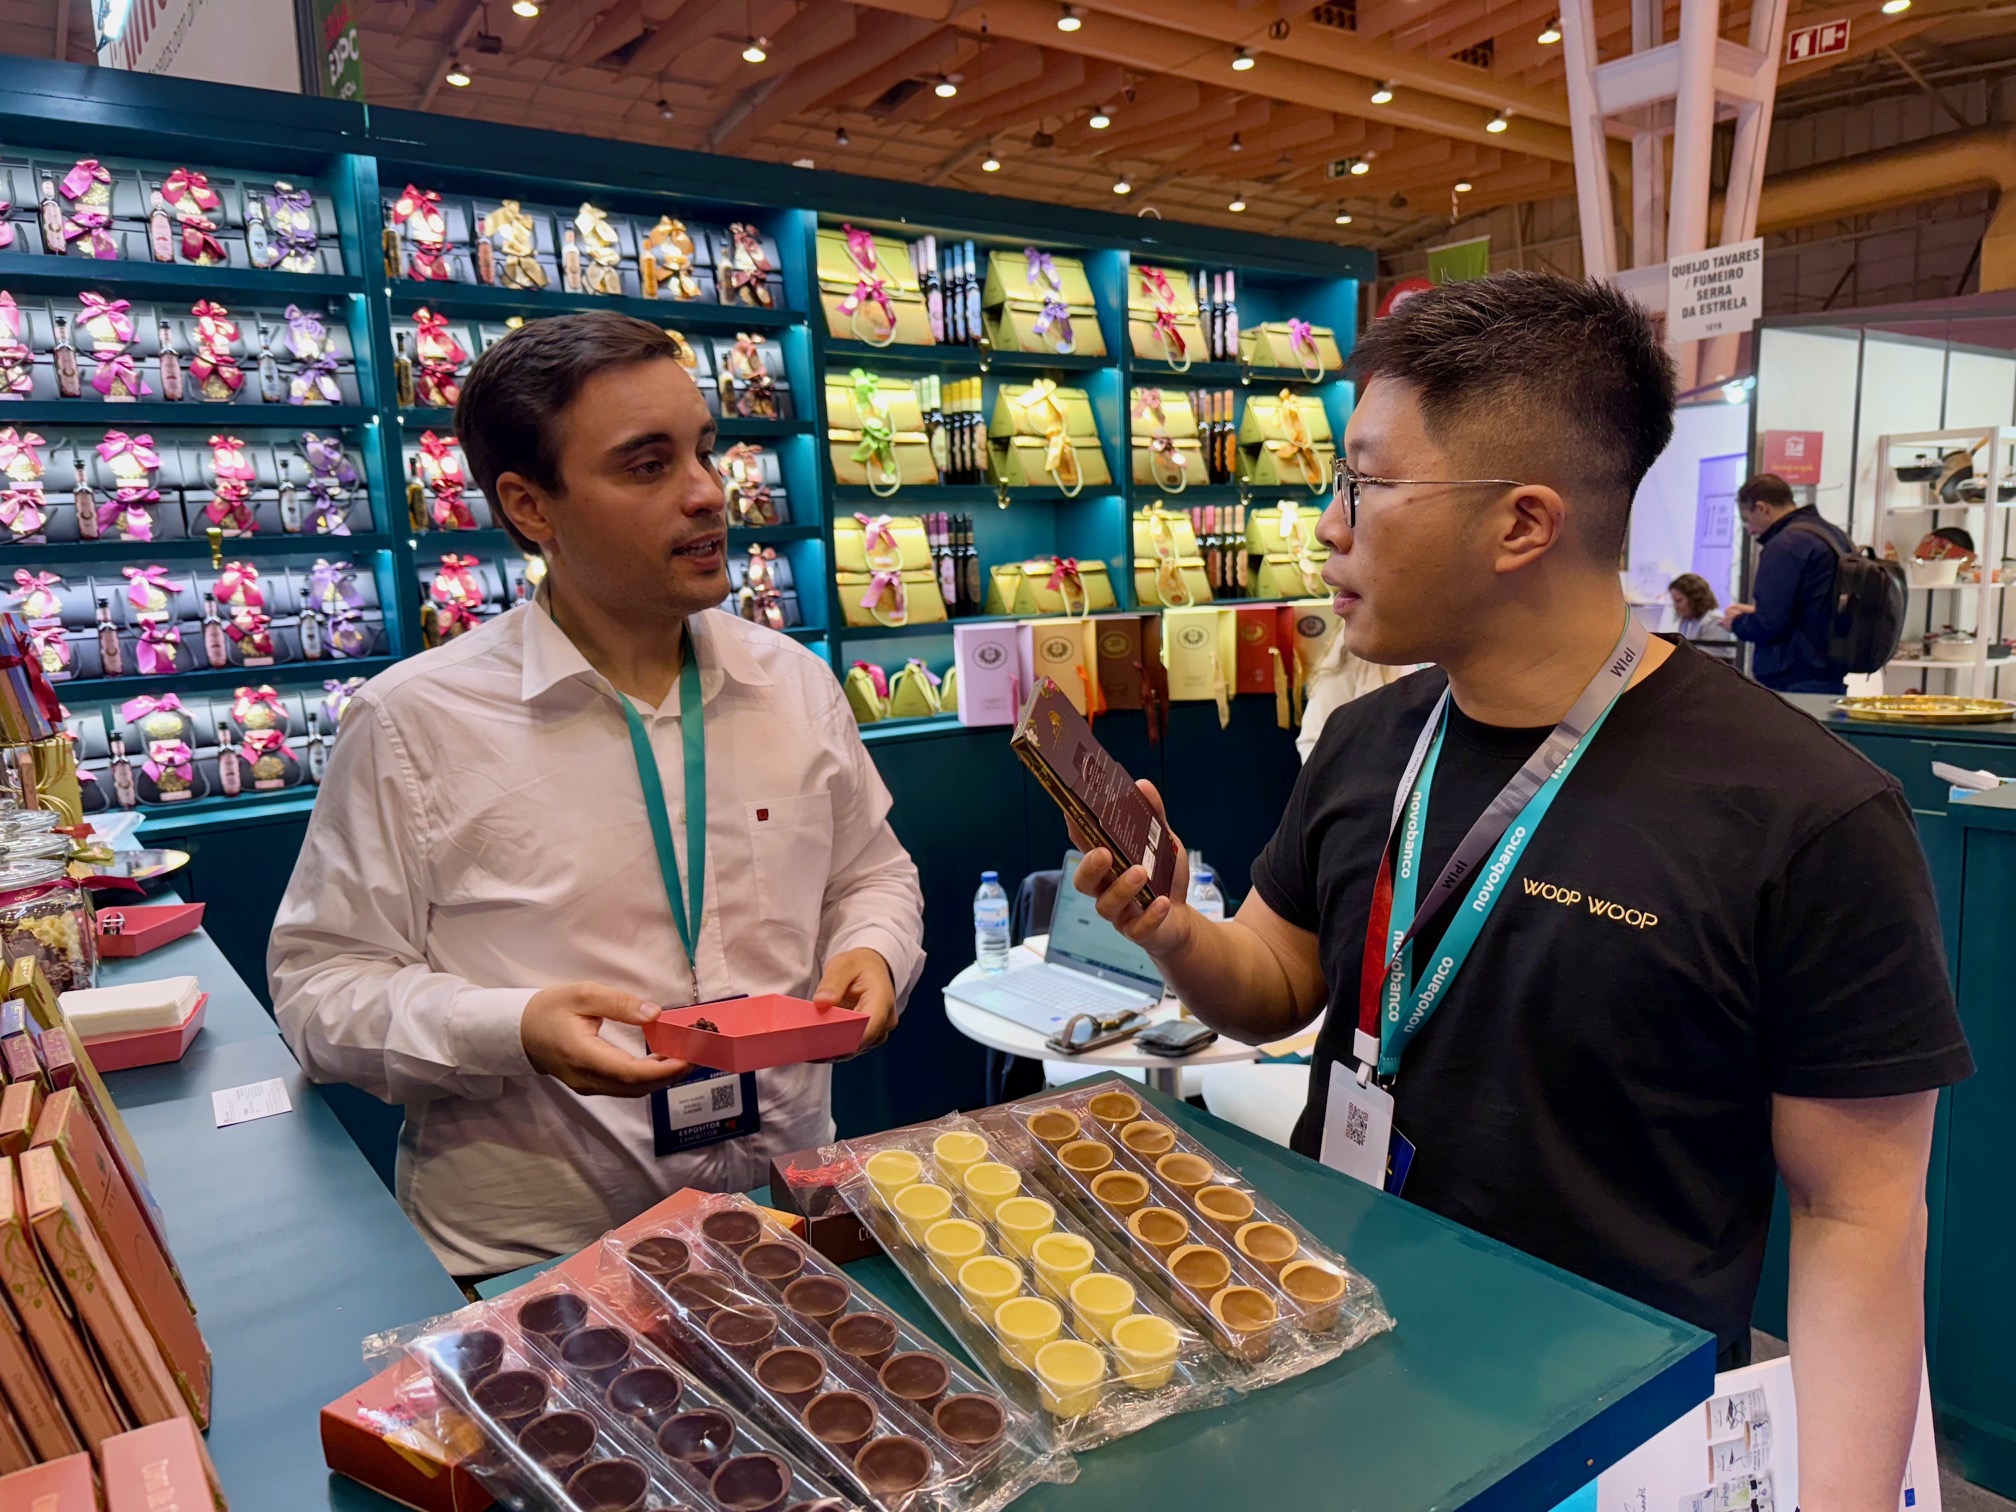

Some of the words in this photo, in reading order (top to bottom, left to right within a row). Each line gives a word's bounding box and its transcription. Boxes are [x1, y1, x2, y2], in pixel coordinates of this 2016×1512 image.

[1672, 260, 1709, 278] QUEIJO
[1713, 248, 1760, 268] TAVARES
[1693, 267, 1744, 288] FUMEIRO
[1682, 306, 1696, 319] DA
[1700, 296, 1747, 316] ESTRELA
[1696, 285, 1732, 302] SERRA
[1610, 647, 1636, 678] IPIM
[1410, 757, 1420, 774] Your
[1401, 791, 1422, 879] novobanco
[1441, 860, 1468, 889] IPIM
[1472, 825, 1527, 912] novobanco
[1523, 877, 1582, 906] WOOP
[1588, 895, 1659, 929] WOOP
[1388, 930, 1405, 1022] novobanco
[1404, 956, 1454, 1033] novobanco
[679, 1121, 720, 1137] EXPOSITOR
